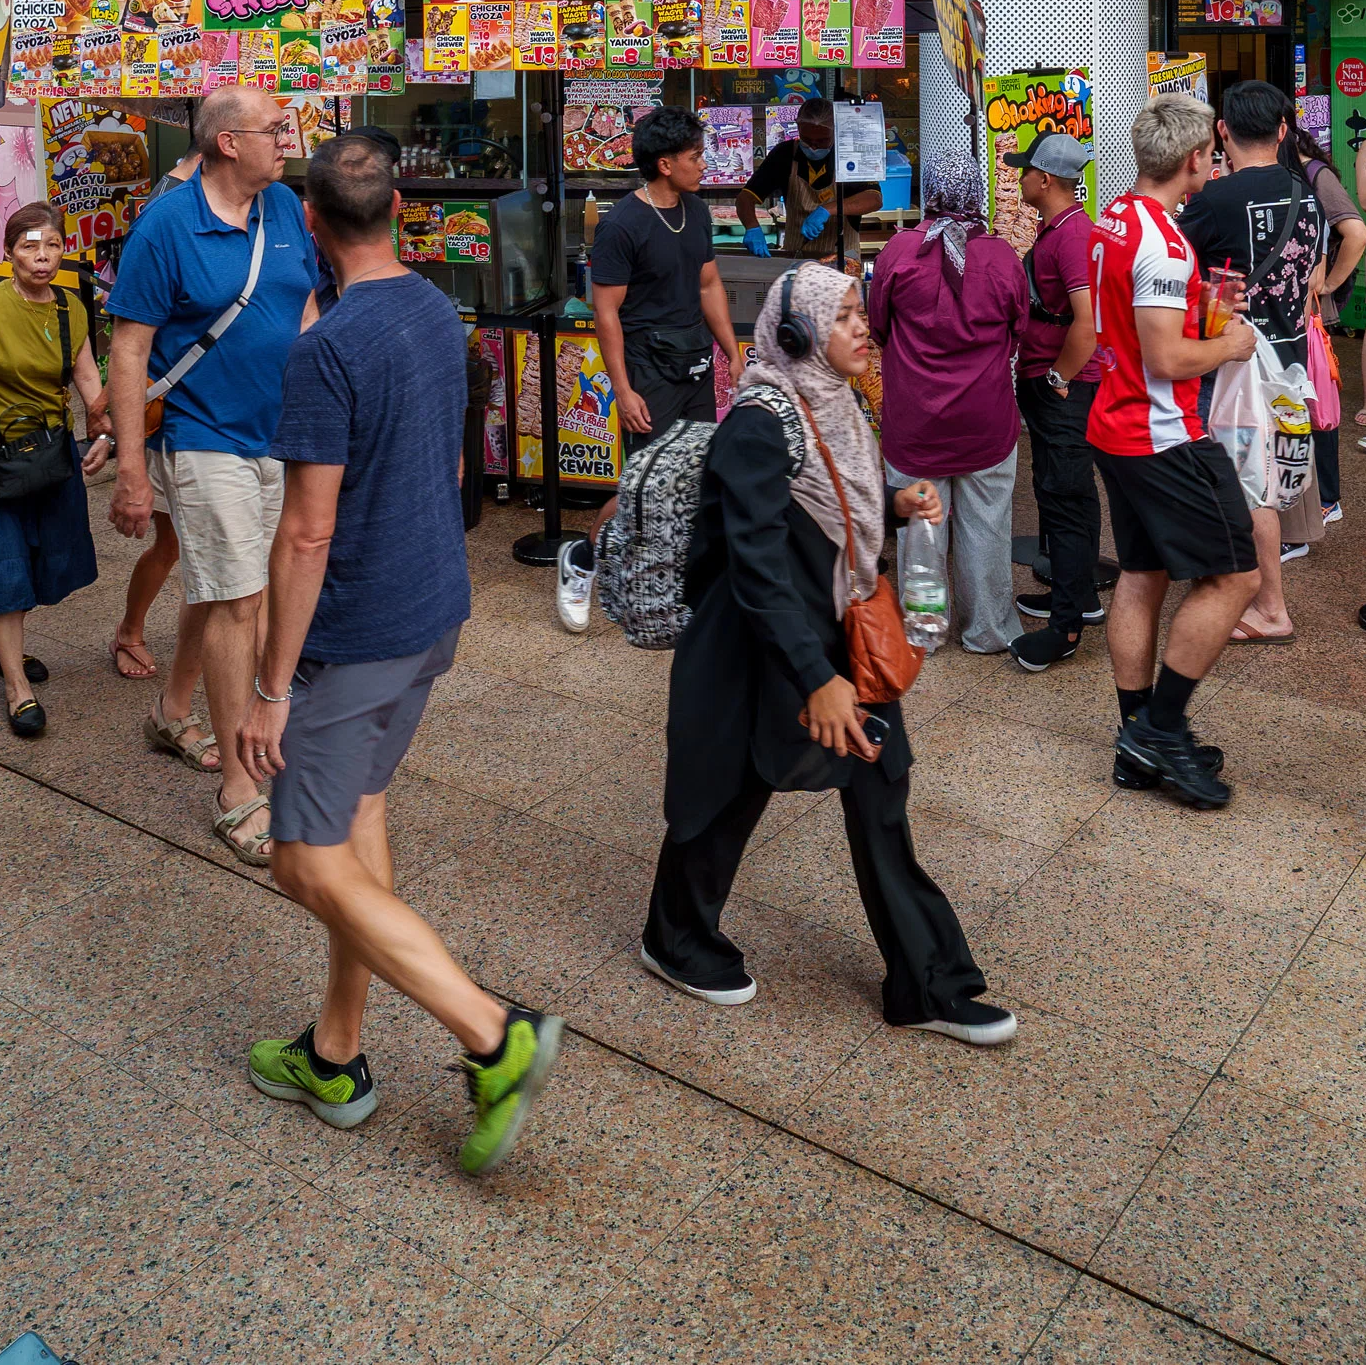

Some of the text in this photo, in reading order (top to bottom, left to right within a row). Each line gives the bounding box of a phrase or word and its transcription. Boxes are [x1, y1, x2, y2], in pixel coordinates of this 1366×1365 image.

[13, 3, 65, 17] CHICKEN
[470, 4, 510, 12] CHICKEN
[558, 5, 592, 14] JAPANESE
[653, 2, 688, 12] JAPANESE
[657, 9, 685, 18] WAGYU
[470, 12, 504, 20] GYOZA
[562, 11, 587, 19] WAGYU
[563, 16, 589, 25] BURGER
[658, 15, 685, 23] BURGER
[13, 18, 57, 31] GYOZA
[14, 34, 53, 51] GYOZA
[83, 33, 122, 48] GYOZA
[160, 33, 202, 48] GYOZA
[324, 28, 368, 44] GYOZA
[609, 38, 650, 47] YAKIIMO
[282, 66, 308, 74] WAGYU
[367, 65, 403, 75] YAKIIMO
[1341, 62, 1364, 71] Japan's
[1149, 69, 1180, 85] FRESHLY
[1341, 70, 1364, 81] No.1
[1338, 79, 1356, 87] Green
[1343, 86, 1363, 94] Brand
[50, 99, 84, 128] NEW
[987, 85, 1067, 133] Shocking
[58, 173, 107, 192] WAGYU
[50, 185, 113, 208] MEATBALL
[67, 199, 99, 216] 8PCS
[564, 407, 608, 429] 人気商品
[557, 417, 616, 444] BEST SELLER
[558, 443, 611, 460] AGYU
[558, 460, 615, 477] KEWER
